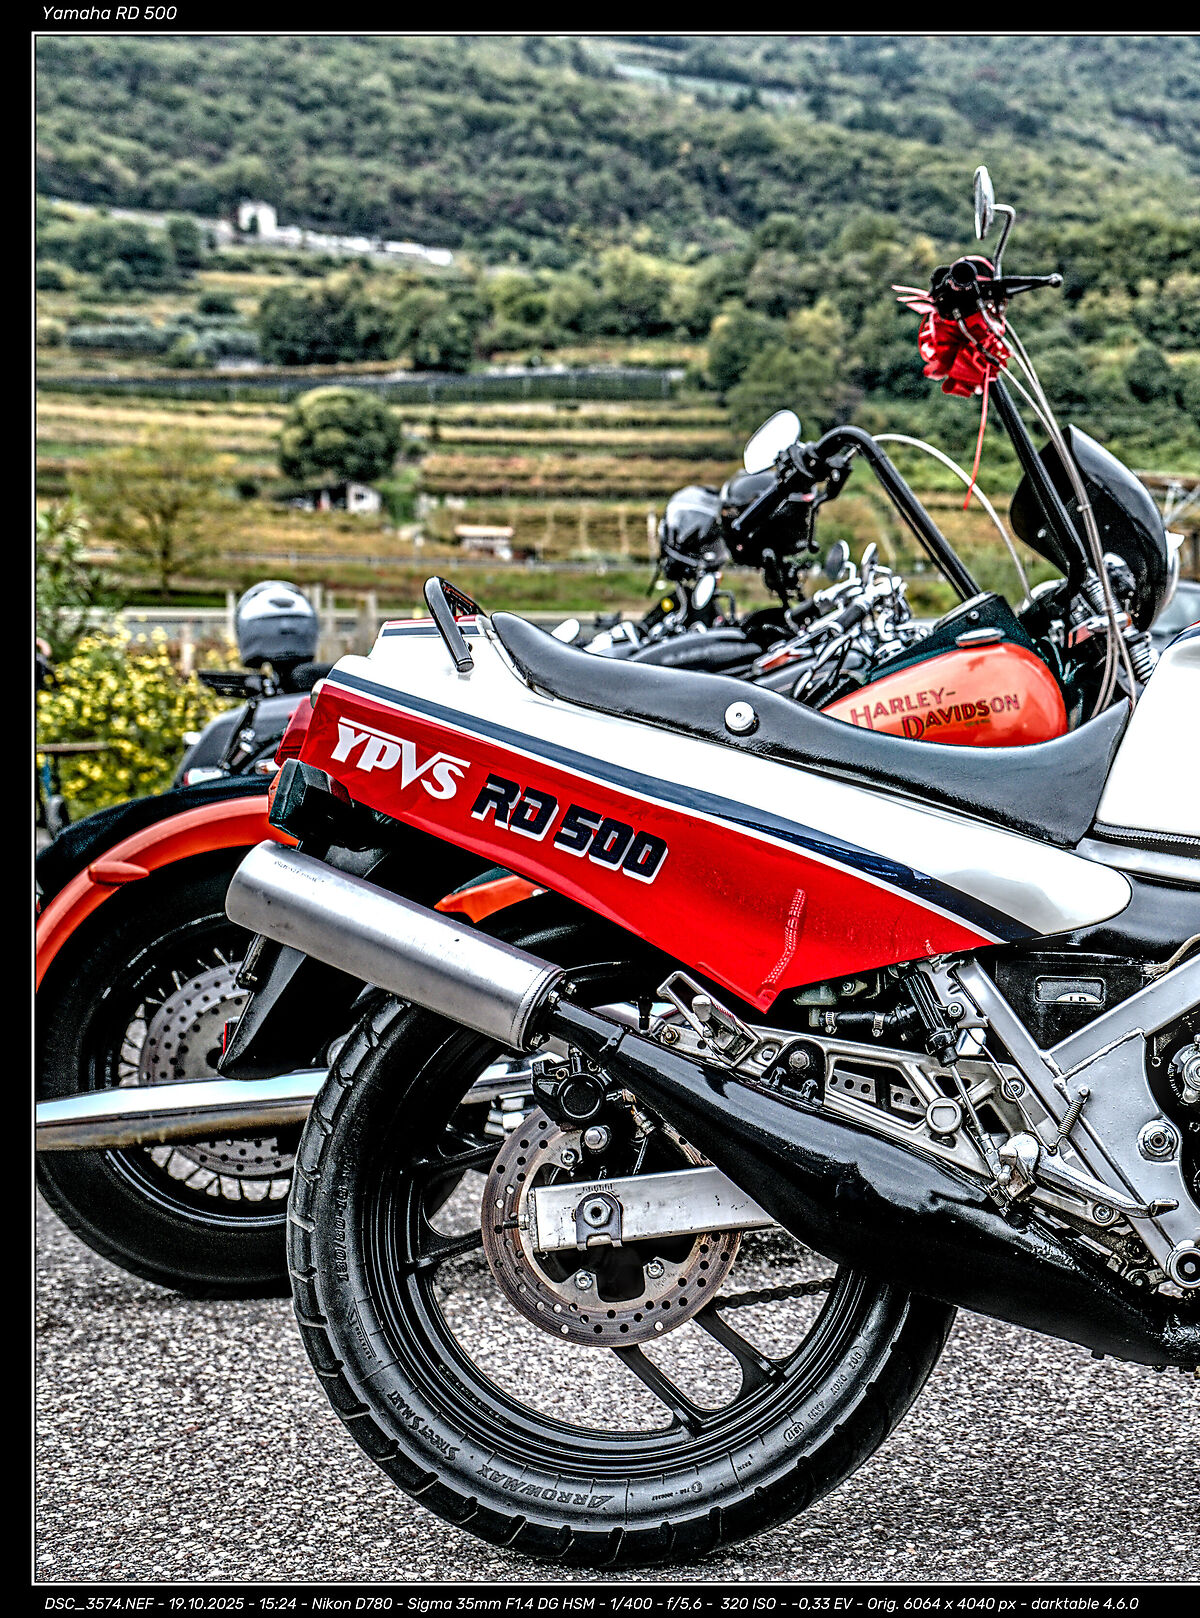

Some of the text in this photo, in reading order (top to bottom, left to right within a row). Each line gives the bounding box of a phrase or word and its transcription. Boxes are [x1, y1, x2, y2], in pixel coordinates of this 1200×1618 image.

[850, 687, 956, 729] HARLEY-
[901, 693, 1020, 739] DAVIDSON
[331, 716, 471, 800] YPVS
[470, 772, 669, 885] RD 500
[476, 1463, 615, 1509] ARROWMAX
